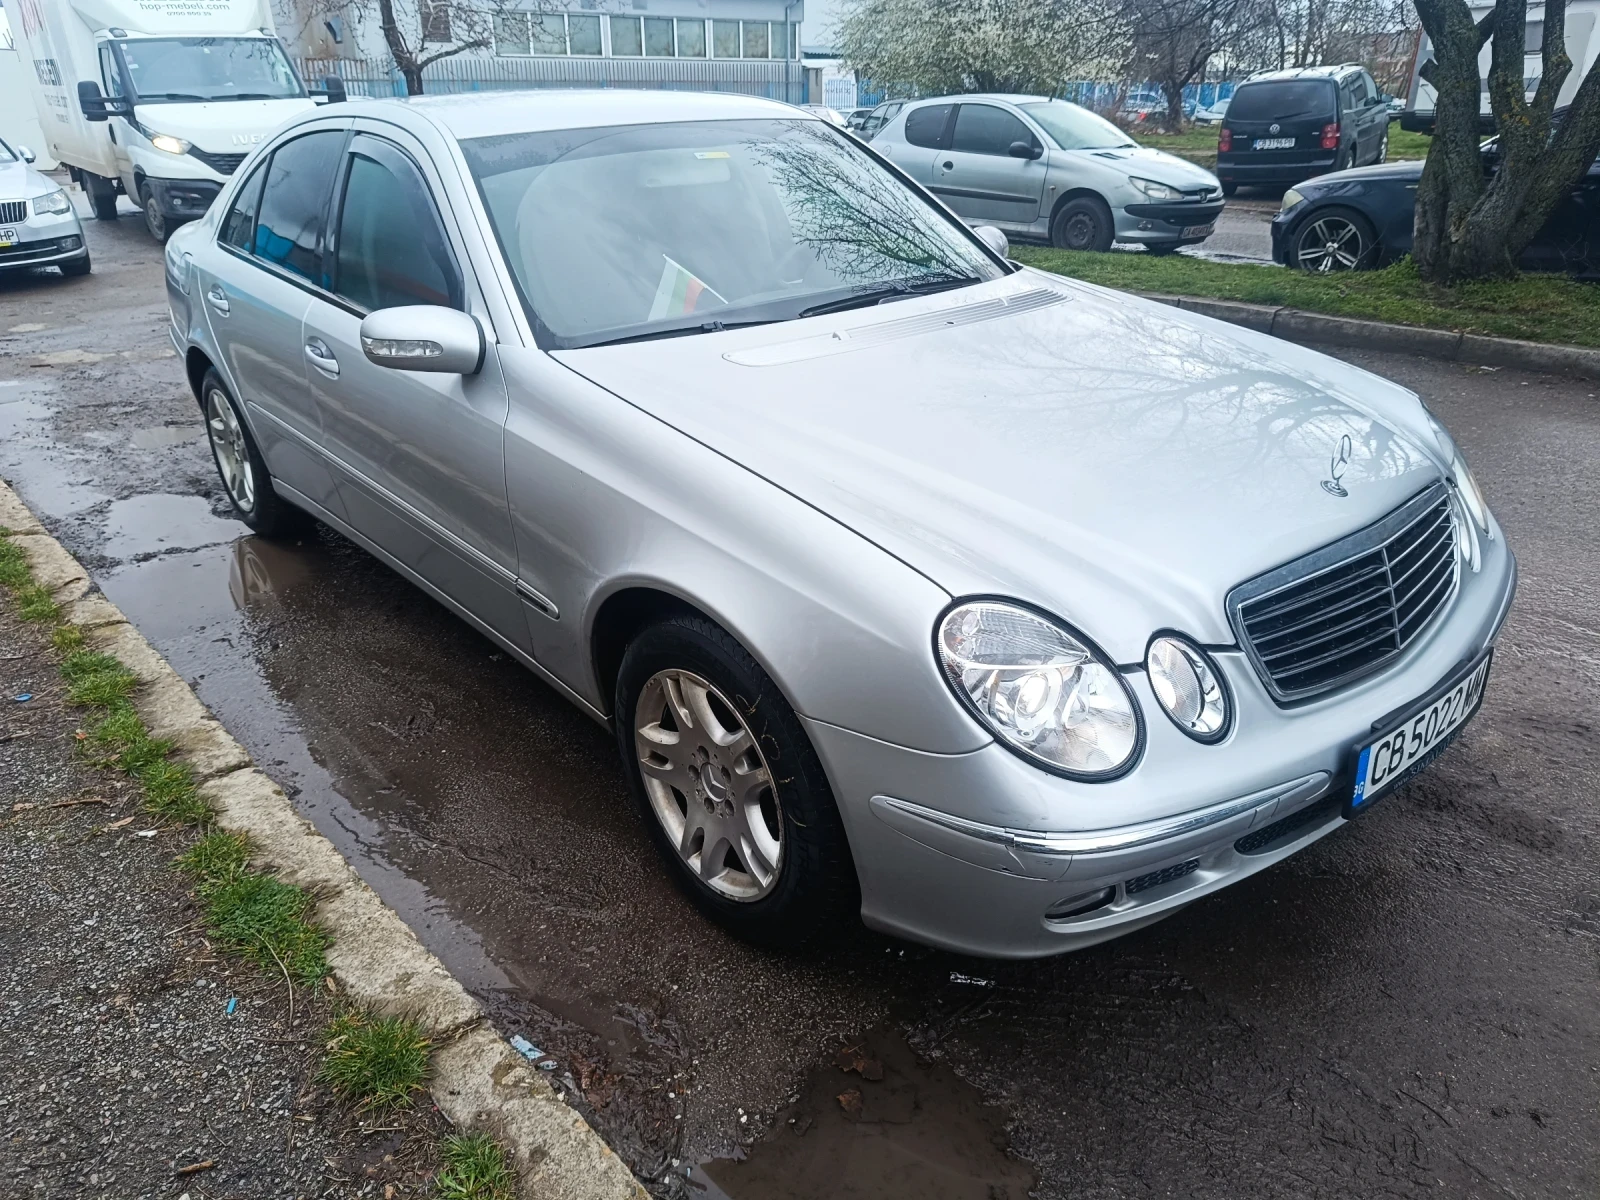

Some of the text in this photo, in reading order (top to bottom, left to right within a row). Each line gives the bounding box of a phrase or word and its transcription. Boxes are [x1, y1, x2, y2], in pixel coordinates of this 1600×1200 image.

[139, 3, 230, 11] hop-mebeli.com
[1371, 729, 1406, 786] CB
[1407, 686, 1463, 760] 5022
